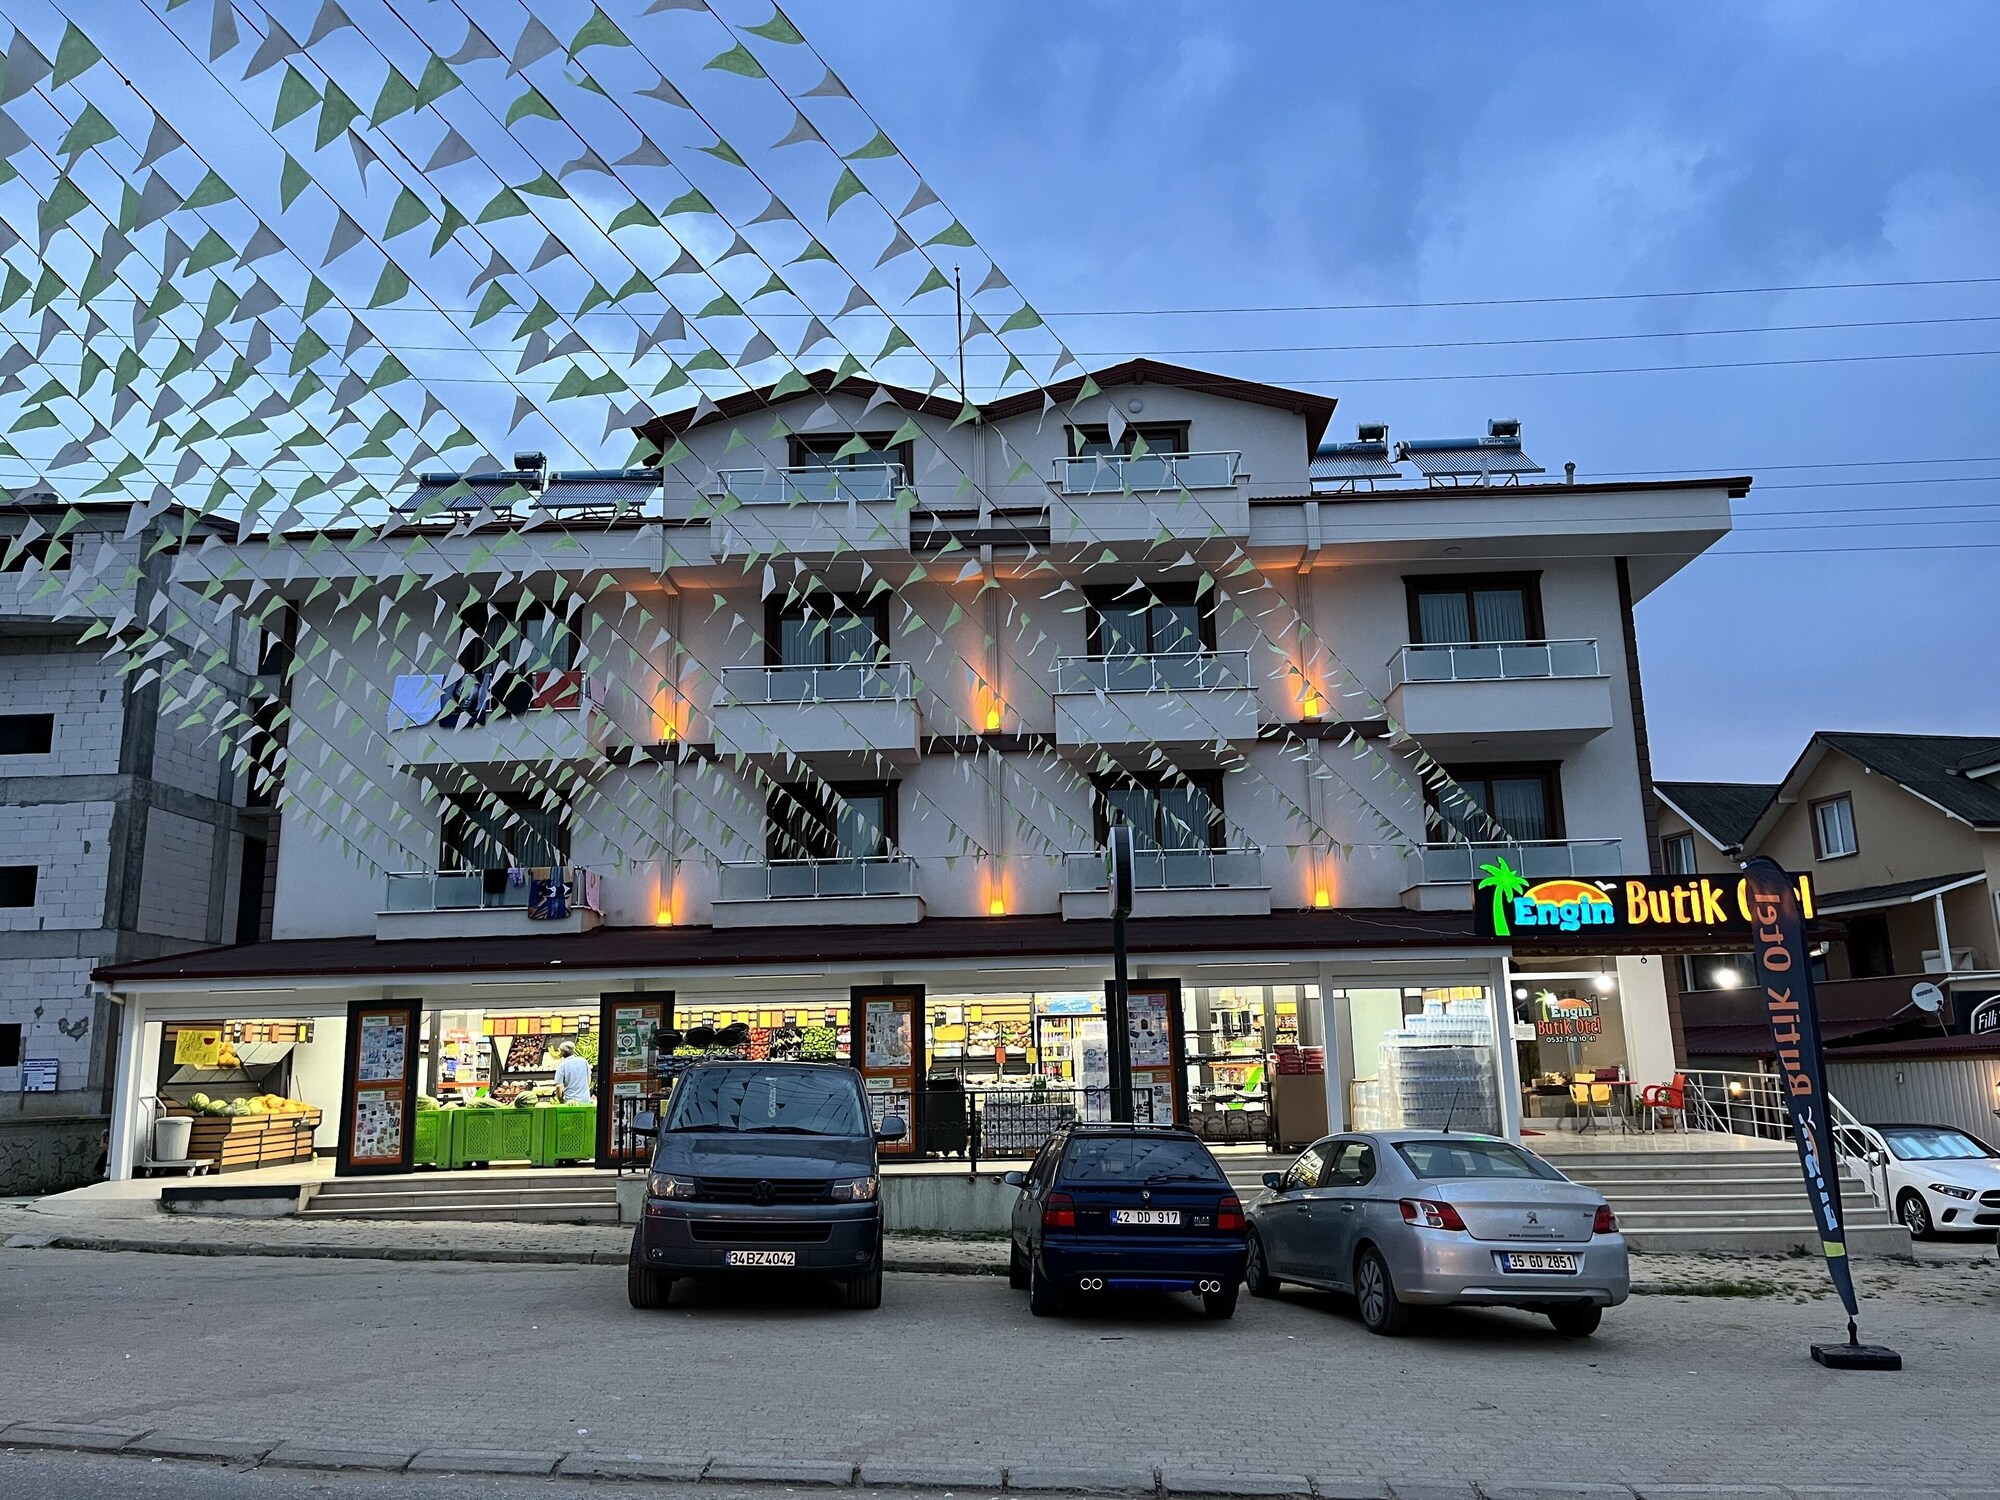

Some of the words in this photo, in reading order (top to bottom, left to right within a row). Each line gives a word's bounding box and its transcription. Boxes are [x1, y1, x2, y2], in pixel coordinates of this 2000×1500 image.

[1625, 879, 1728, 924] Butik
[1513, 896, 1616, 931] Engin
[1551, 1005, 1592, 1020] Engin
[1978, 1009, 1998, 1030] Filli
[1537, 1019, 1572, 1035] Butik
[1575, 1017, 1602, 1034] Otel
[1546, 1035, 1564, 1043] 0532
[1566, 1035, 1578, 1043] 748
[1579, 1034, 1587, 1042] 10
[1589, 1034, 1597, 1042] 41
[1116, 1212, 1130, 1223] 42
[1137, 1212, 1151, 1223] DD
[1158, 1212, 1178, 1224] 917
[1510, 1255, 1525, 1267] 35
[1546, 1255, 1573, 1269] 2851
